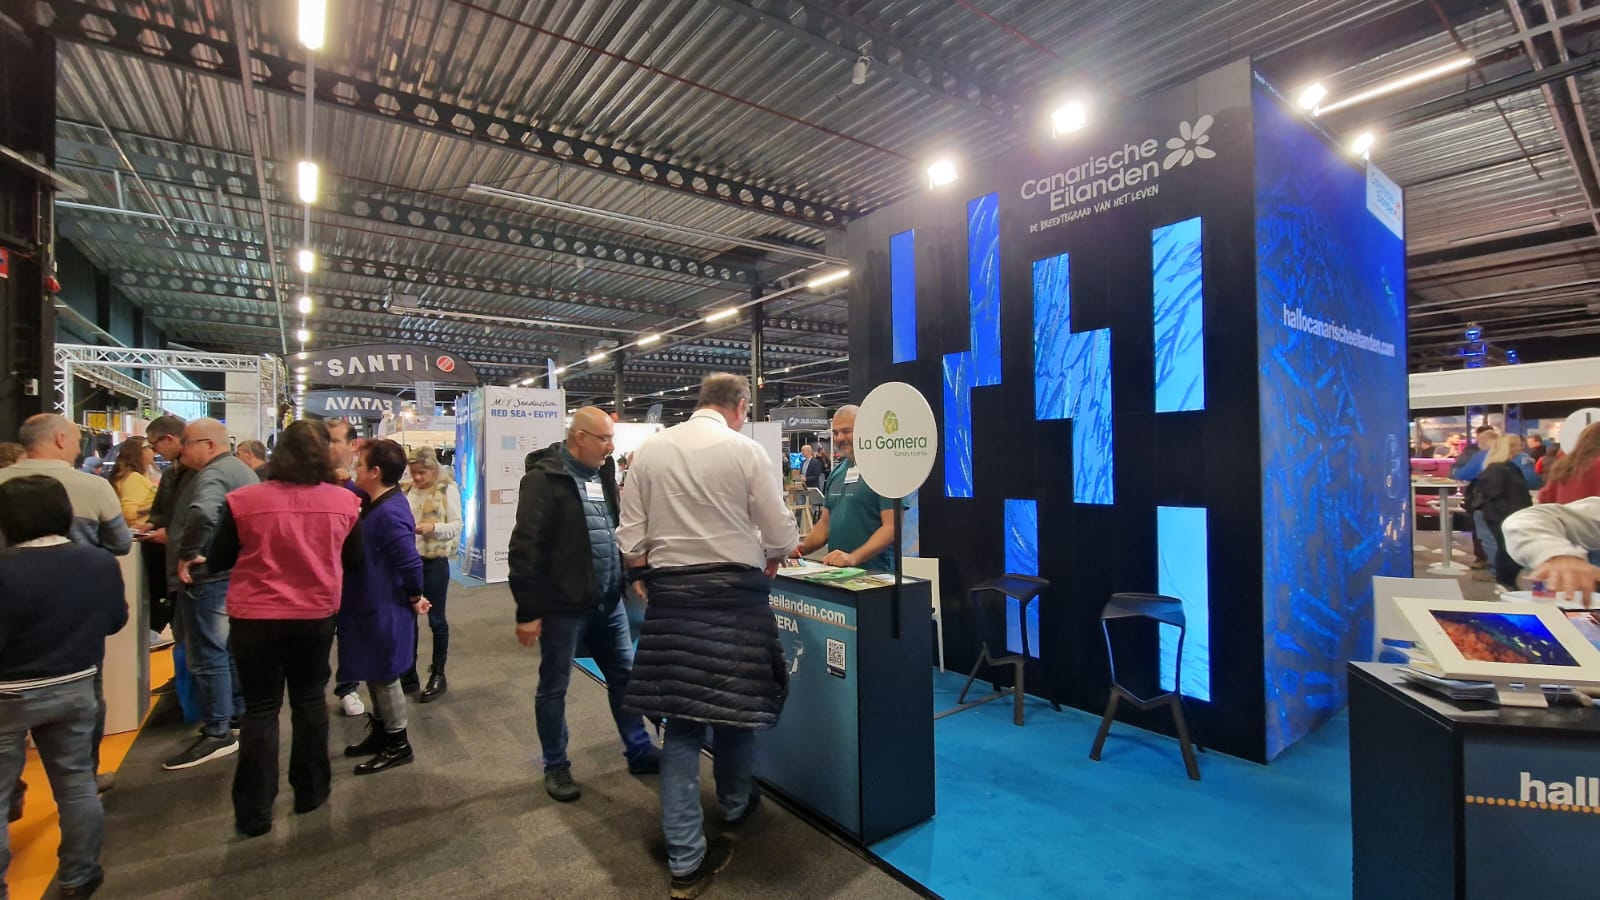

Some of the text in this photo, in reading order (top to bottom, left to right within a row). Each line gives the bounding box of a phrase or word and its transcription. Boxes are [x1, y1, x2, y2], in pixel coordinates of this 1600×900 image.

[1020, 138, 1159, 200] Canarische
[1050, 161, 1160, 212] Eilanden
[1030, 184, 1159, 233] DE BREEDTEGRAAD VAN HET LEVEN
[327, 354, 413, 377] SANTI
[491, 409, 559, 419] RED SEA EGYPT
[858, 435, 928, 450] La Gomera
[775, 613, 799, 634] ERA
